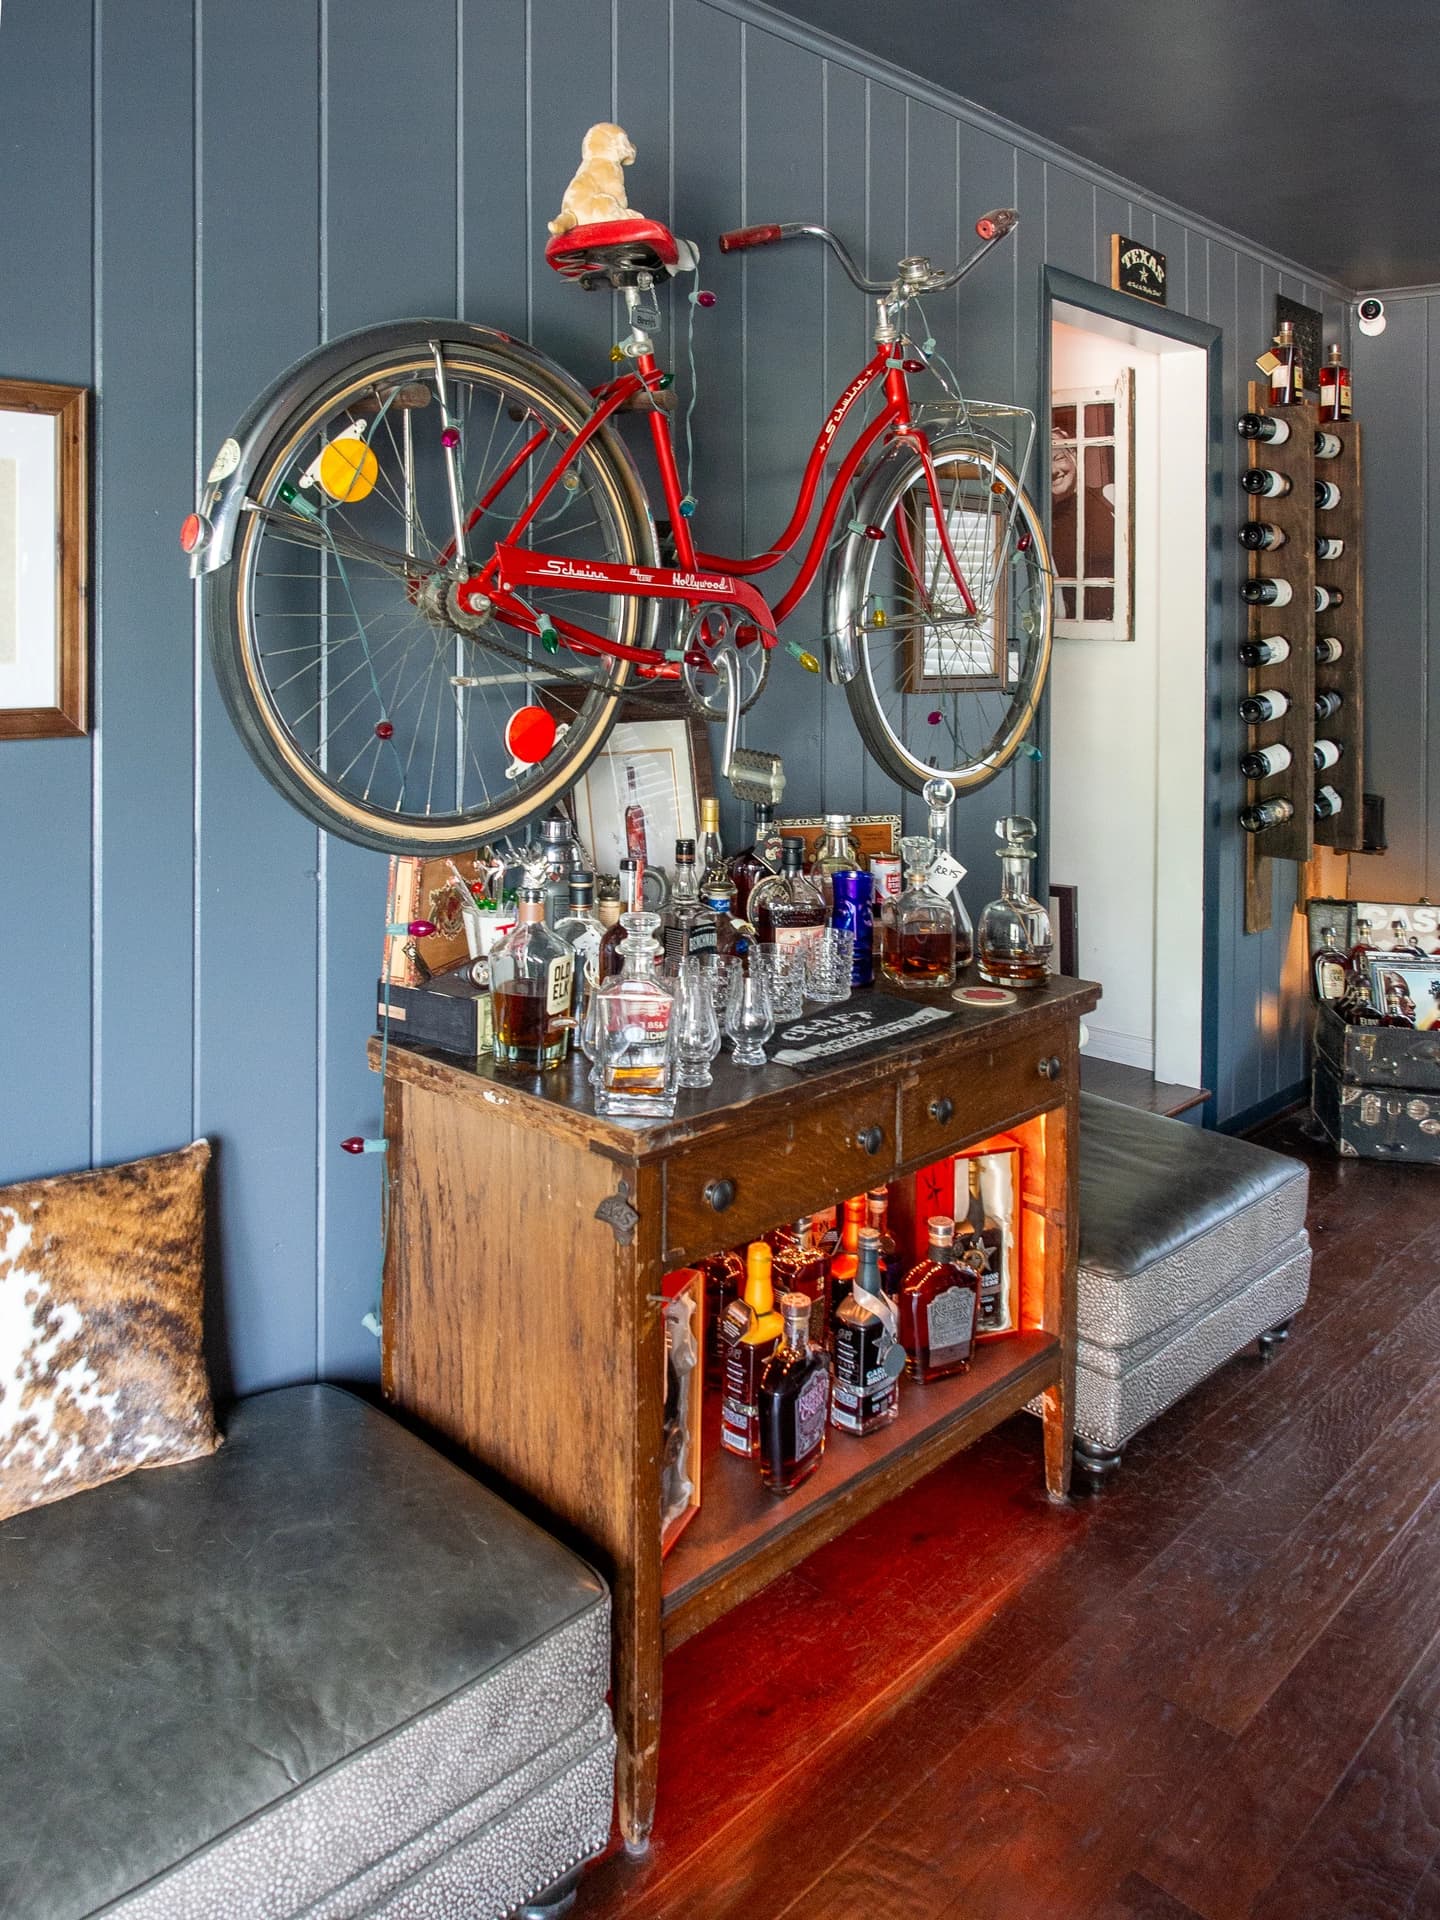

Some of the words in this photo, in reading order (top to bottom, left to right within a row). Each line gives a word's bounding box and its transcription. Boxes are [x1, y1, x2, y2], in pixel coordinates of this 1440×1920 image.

[1121, 248, 1165, 284] TEXAS
[825, 378, 868, 444] Schwinn
[539, 560, 608, 580] Schwinn
[672, 572, 728, 590] Hollywood
[1362, 905, 1440, 932] CAS
[554, 962, 570, 981] OLD
[553, 980, 569, 1000] ELK
[781, 1011, 876, 1041] CRAFT
